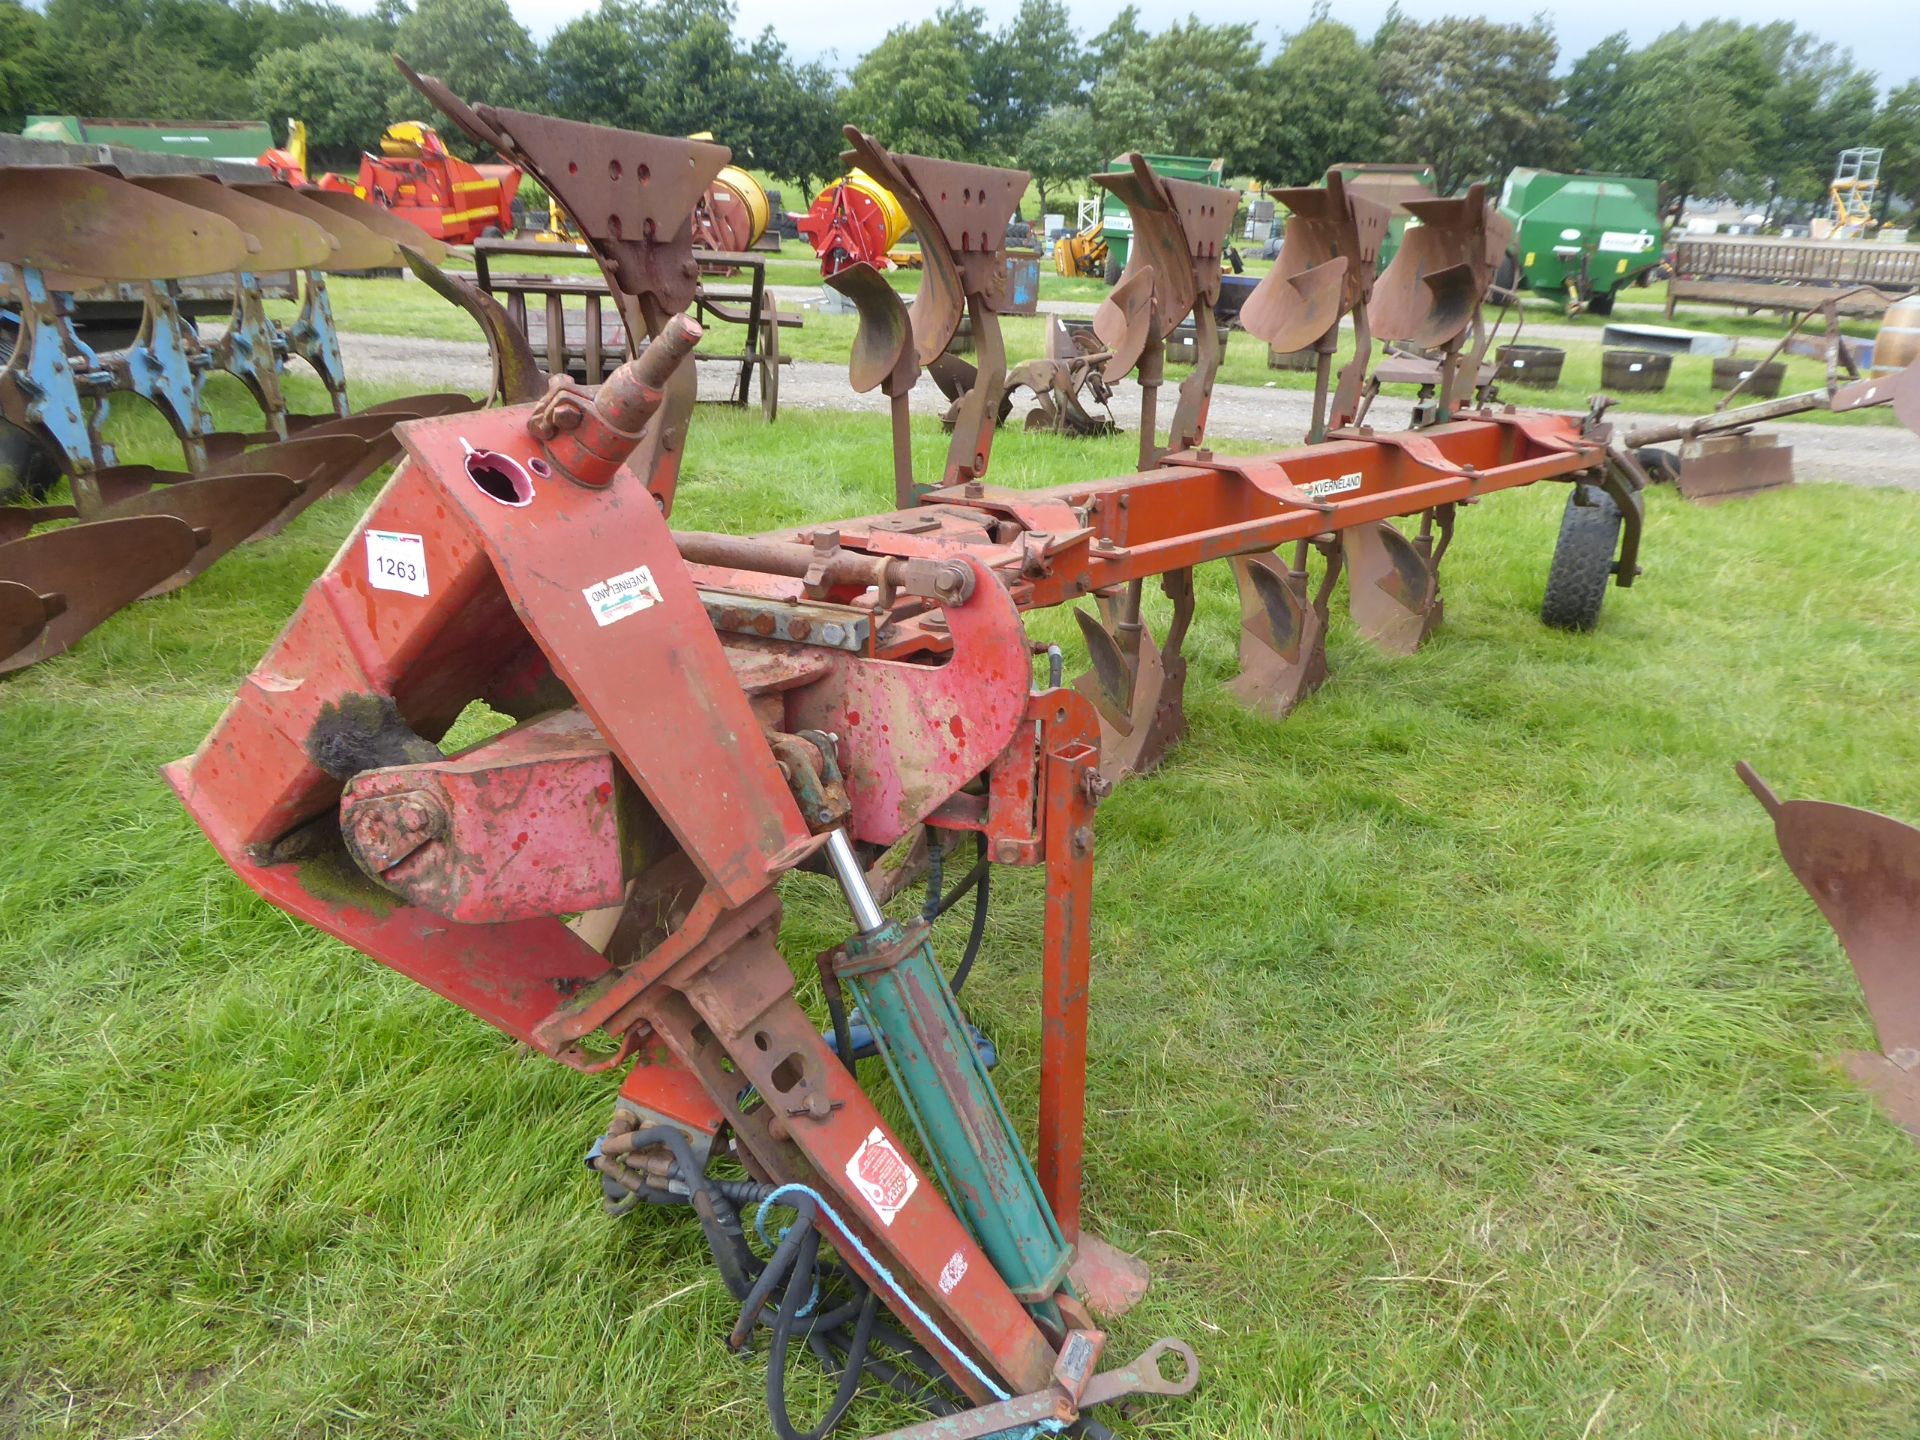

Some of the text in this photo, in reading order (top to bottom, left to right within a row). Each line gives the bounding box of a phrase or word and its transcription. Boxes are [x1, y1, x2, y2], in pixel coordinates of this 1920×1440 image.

[1313, 475, 1360, 494] KVERNELAND
[376, 556, 416, 581] 1263
[591, 570, 648, 602] KVERNELAND
